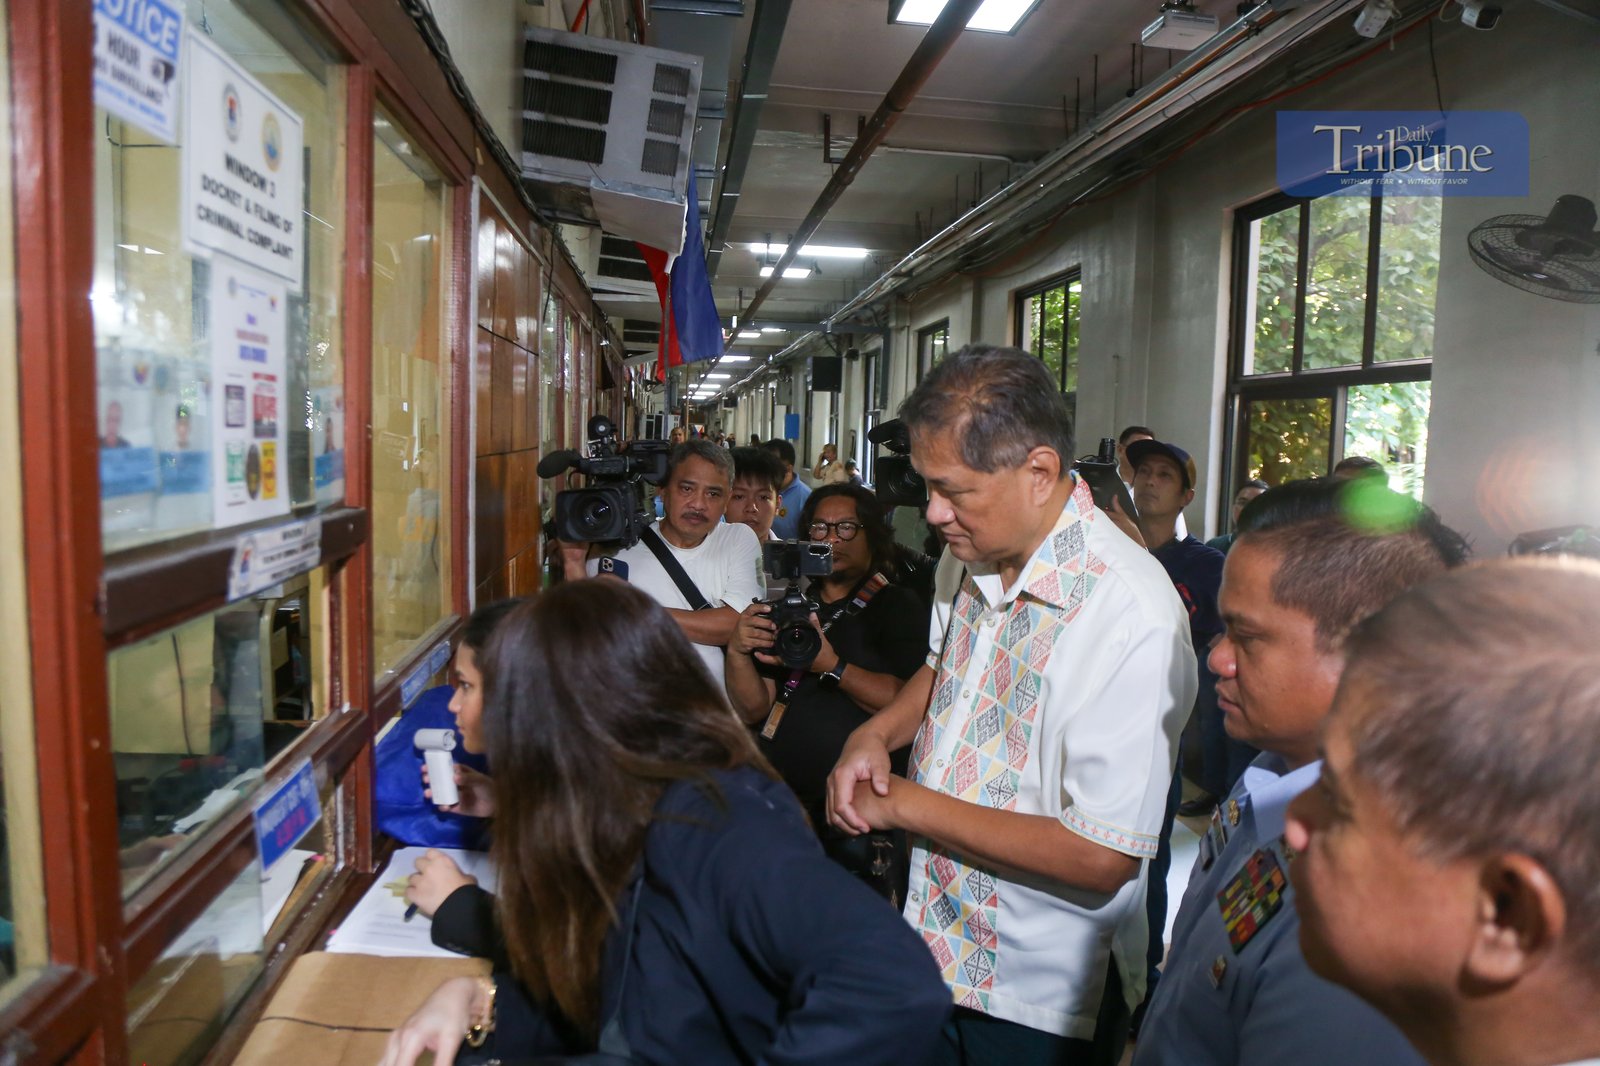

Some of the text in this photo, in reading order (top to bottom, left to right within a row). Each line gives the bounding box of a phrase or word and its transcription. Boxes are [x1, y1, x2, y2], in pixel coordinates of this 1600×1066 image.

[94, 0, 178, 53] OTICE
[225, 152, 267, 192] WINDOW
[201, 173, 242, 208] DOCKET
[254, 202, 281, 230] FILING
[284, 219, 292, 234] OF
[197, 203, 293, 260] CRIMINAL COMPLAINT
